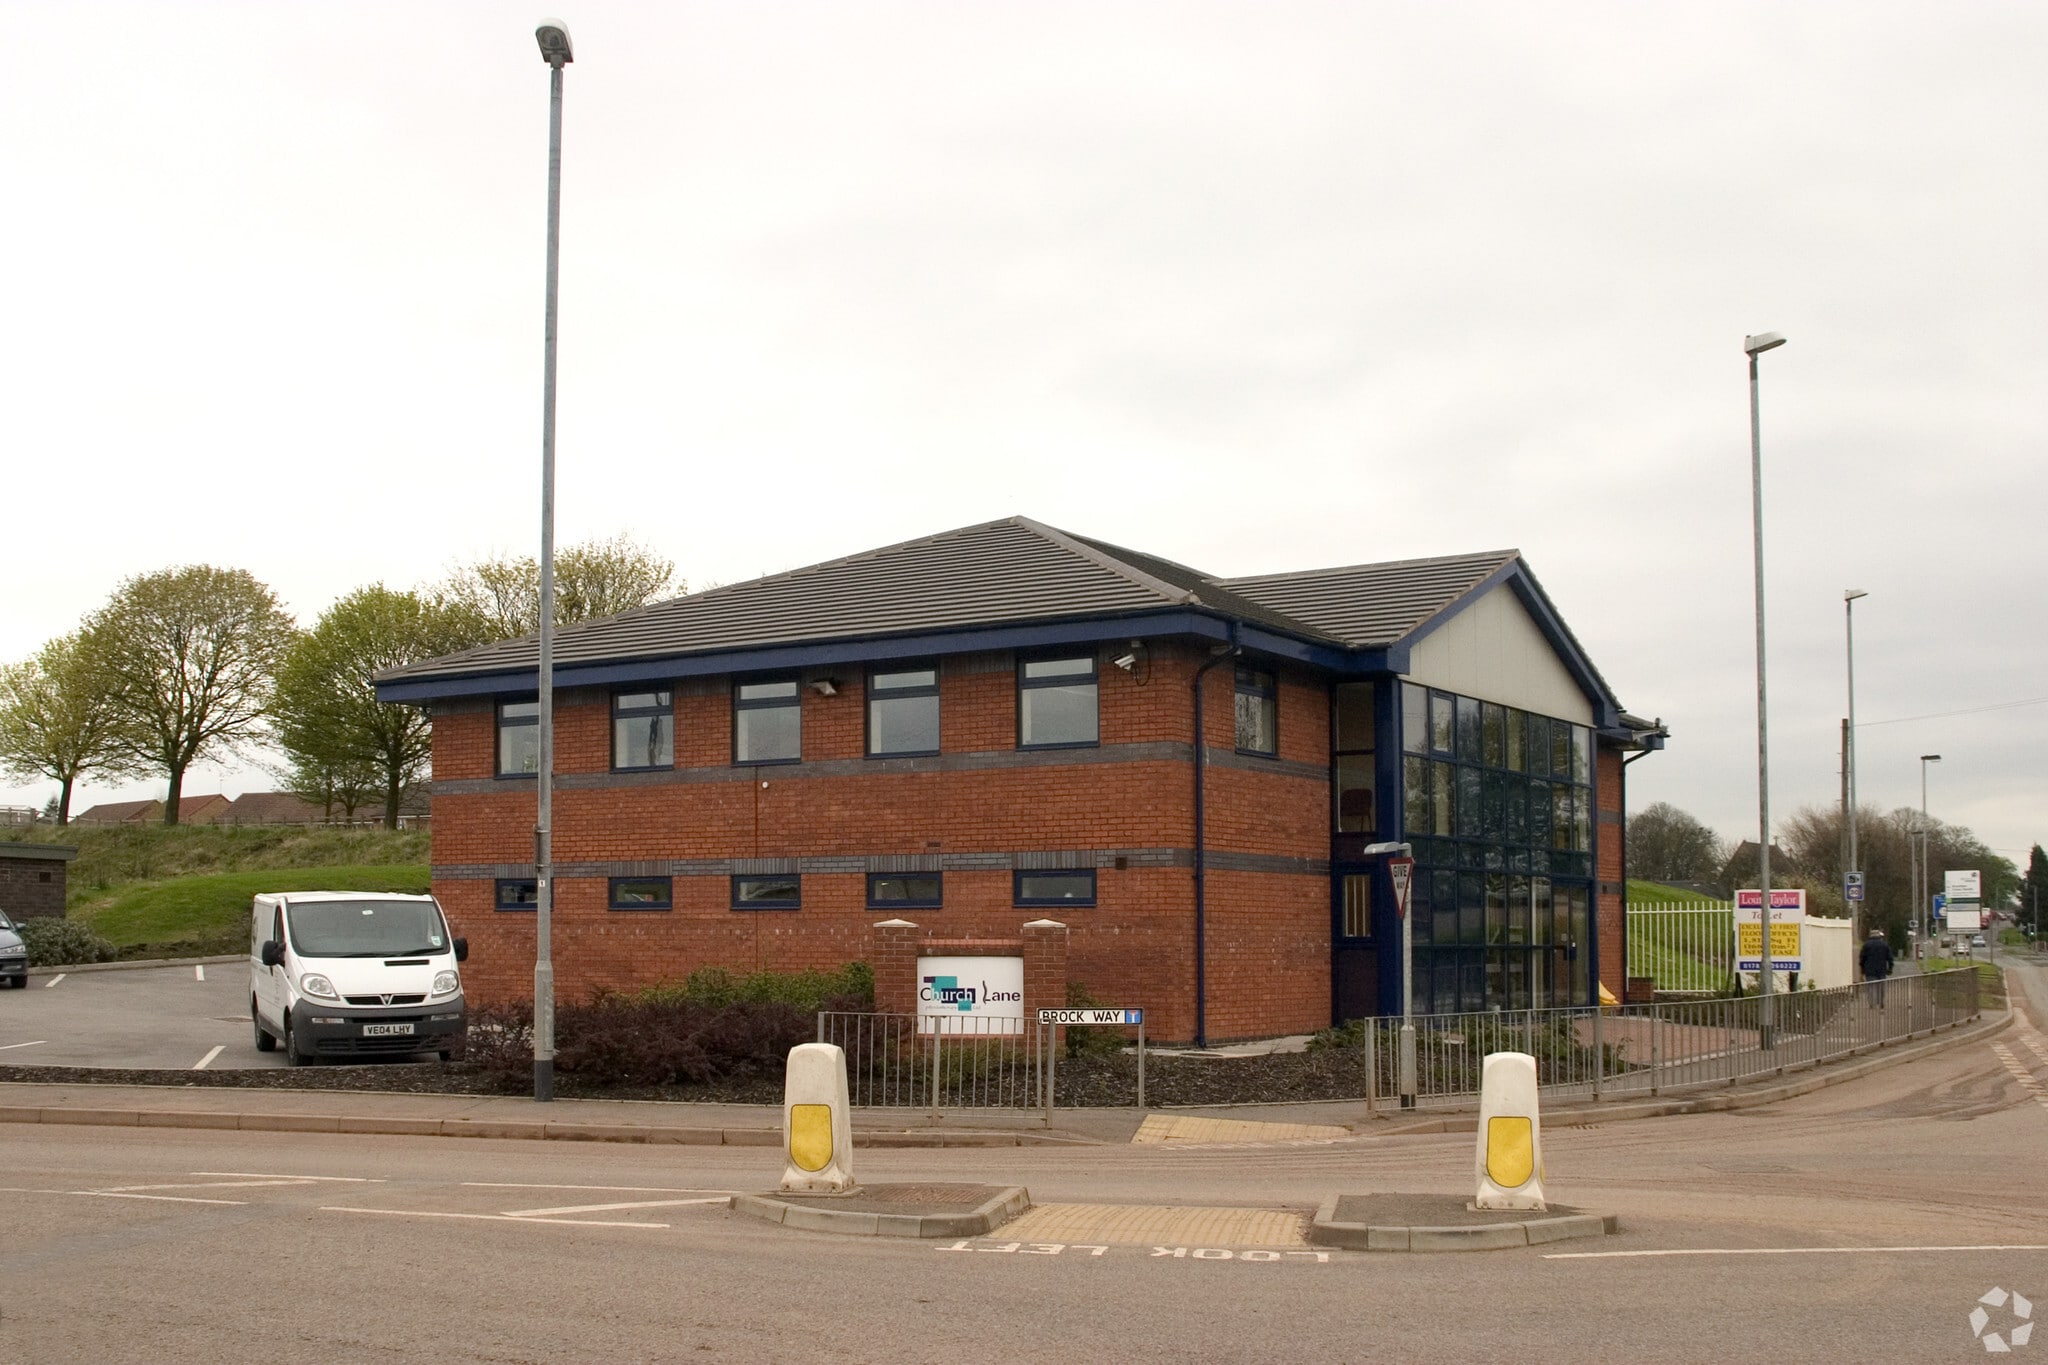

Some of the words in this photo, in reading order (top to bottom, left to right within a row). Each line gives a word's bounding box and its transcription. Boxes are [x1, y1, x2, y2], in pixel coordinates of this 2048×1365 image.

[1393, 865, 1407, 877] GIVE
[1770, 894, 1797, 907] Taylor
[920, 985, 973, 1001] Church
[982, 980, 1021, 1004] Lane
[1042, 1011, 1085, 1023] BROCK
[1093, 1011, 1120, 1022] WAY
[393, 1024, 411, 1034] LHY
[934, 1241, 1109, 1255] LEFT
[1150, 1247, 1329, 1262] LOOK
